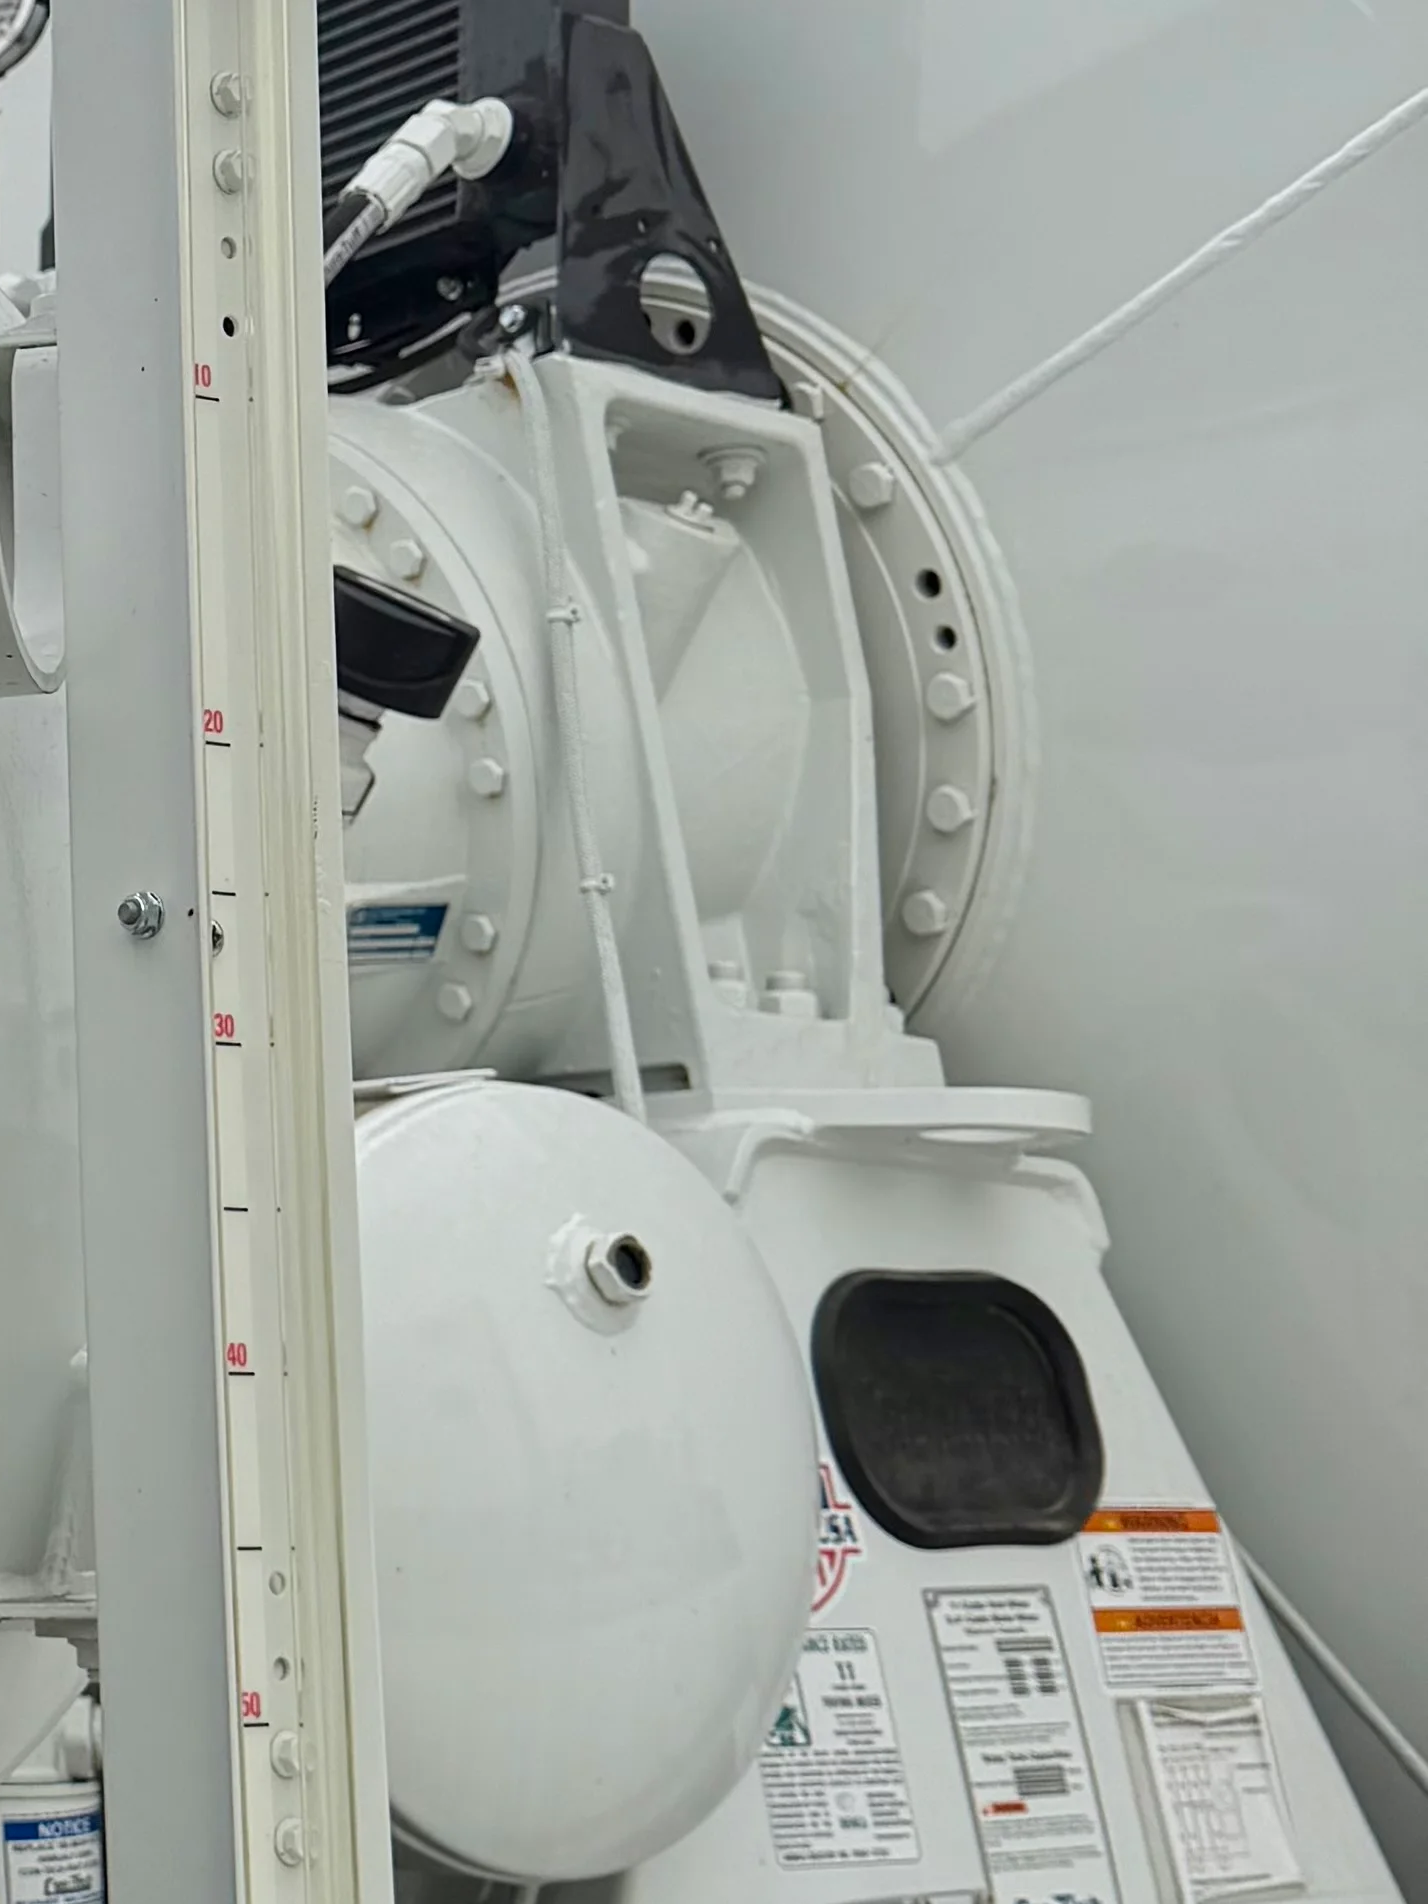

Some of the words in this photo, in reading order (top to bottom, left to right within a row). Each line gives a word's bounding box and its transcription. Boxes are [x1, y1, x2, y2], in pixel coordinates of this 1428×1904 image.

[203, 710, 224, 735] 20
[214, 1014, 235, 1039] 30
[226, 1343, 248, 1366] 40
[241, 1693, 261, 1718] 50
